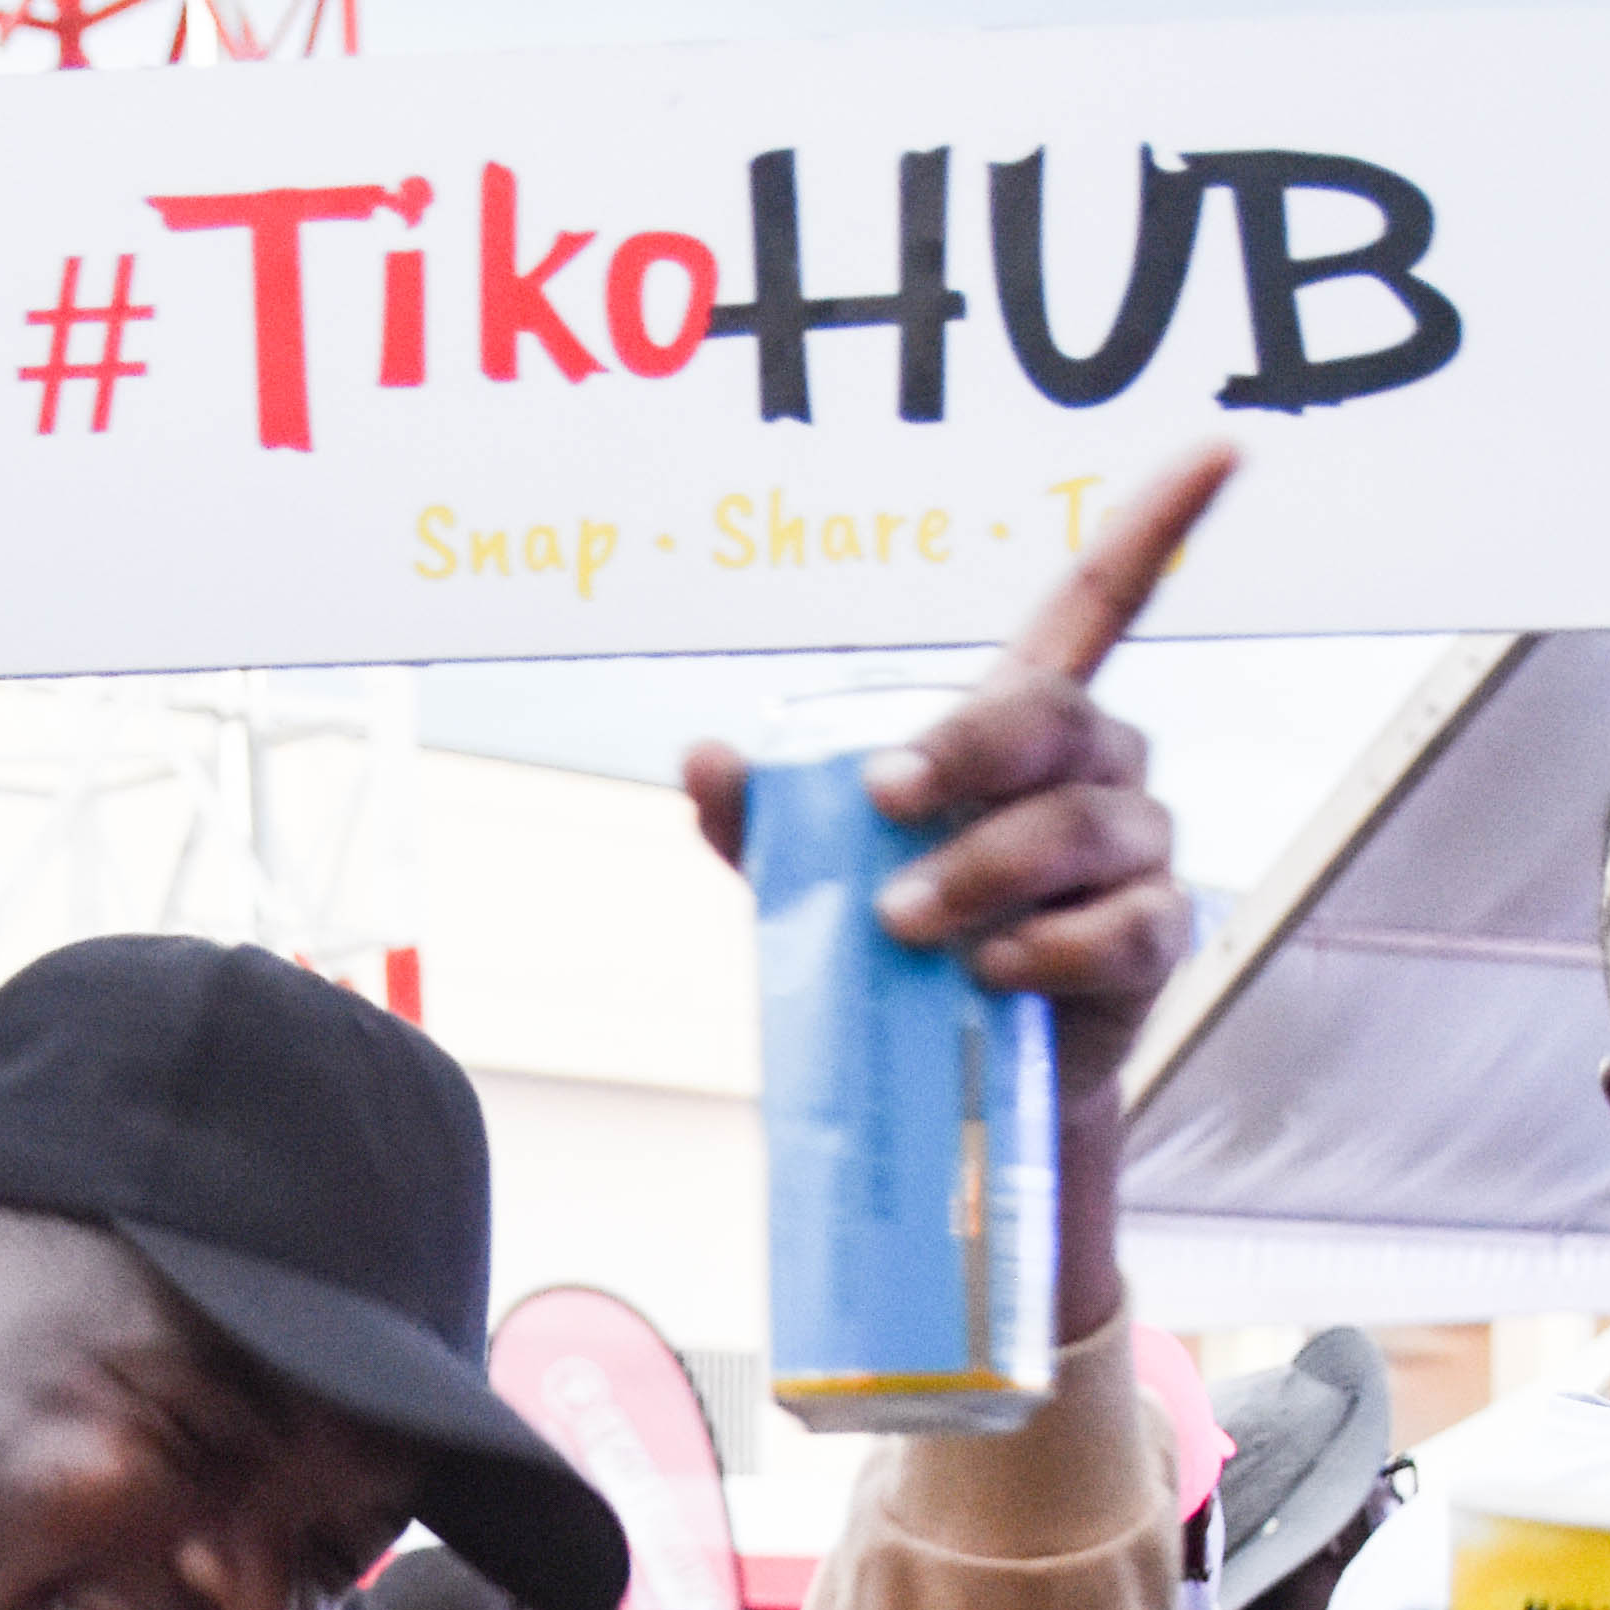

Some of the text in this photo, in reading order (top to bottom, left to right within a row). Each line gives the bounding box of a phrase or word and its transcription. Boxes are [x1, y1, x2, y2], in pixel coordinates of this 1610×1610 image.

[16, 143, 1466, 453] #TikoHUB
[413, 503, 619, 602] Snap
[711, 488, 953, 570] Share
